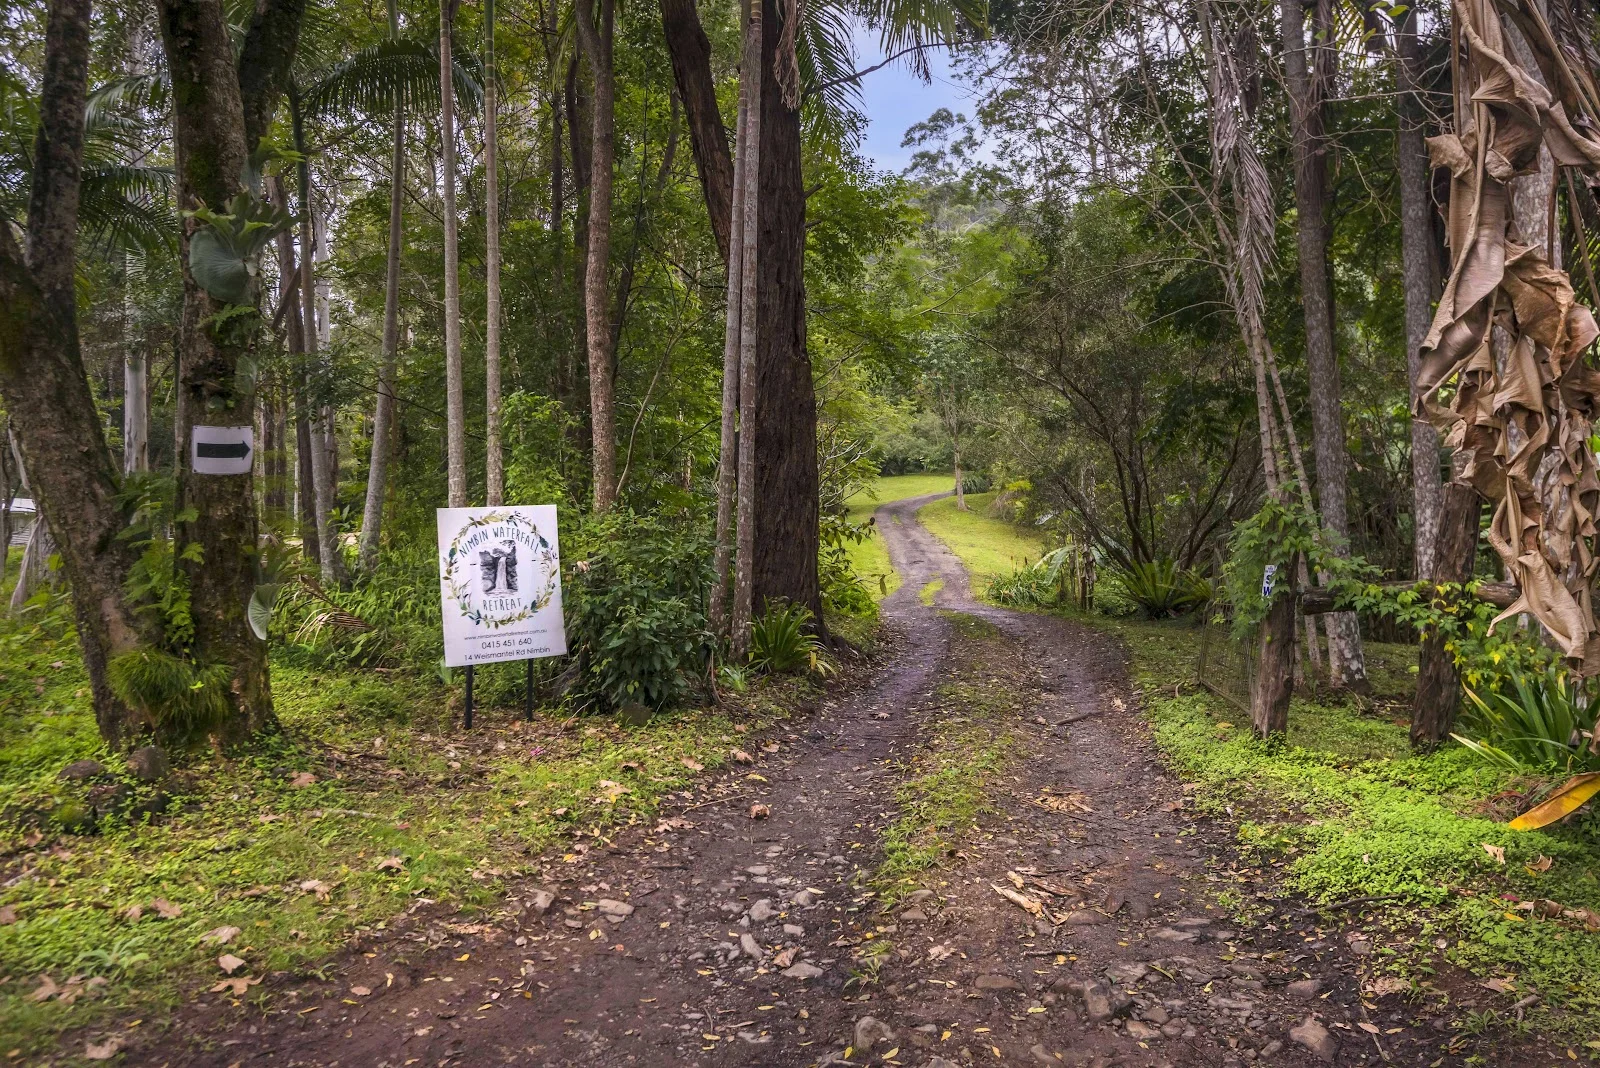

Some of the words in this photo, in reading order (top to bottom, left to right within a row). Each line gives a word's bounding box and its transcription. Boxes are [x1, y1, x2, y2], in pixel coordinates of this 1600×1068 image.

[459, 530, 488, 557] NIMBIN
[492, 527, 540, 554] WATERFALL
[482, 597, 522, 612] RETREAT
[481, 640, 501, 650] 0415
[502, 639, 516, 647] 451
[518, 637, 532, 646] 640
[474, 650, 515, 660] Weismantel
[516, 649, 526, 657] Rd
[526, 646, 551, 655] Nimbin
